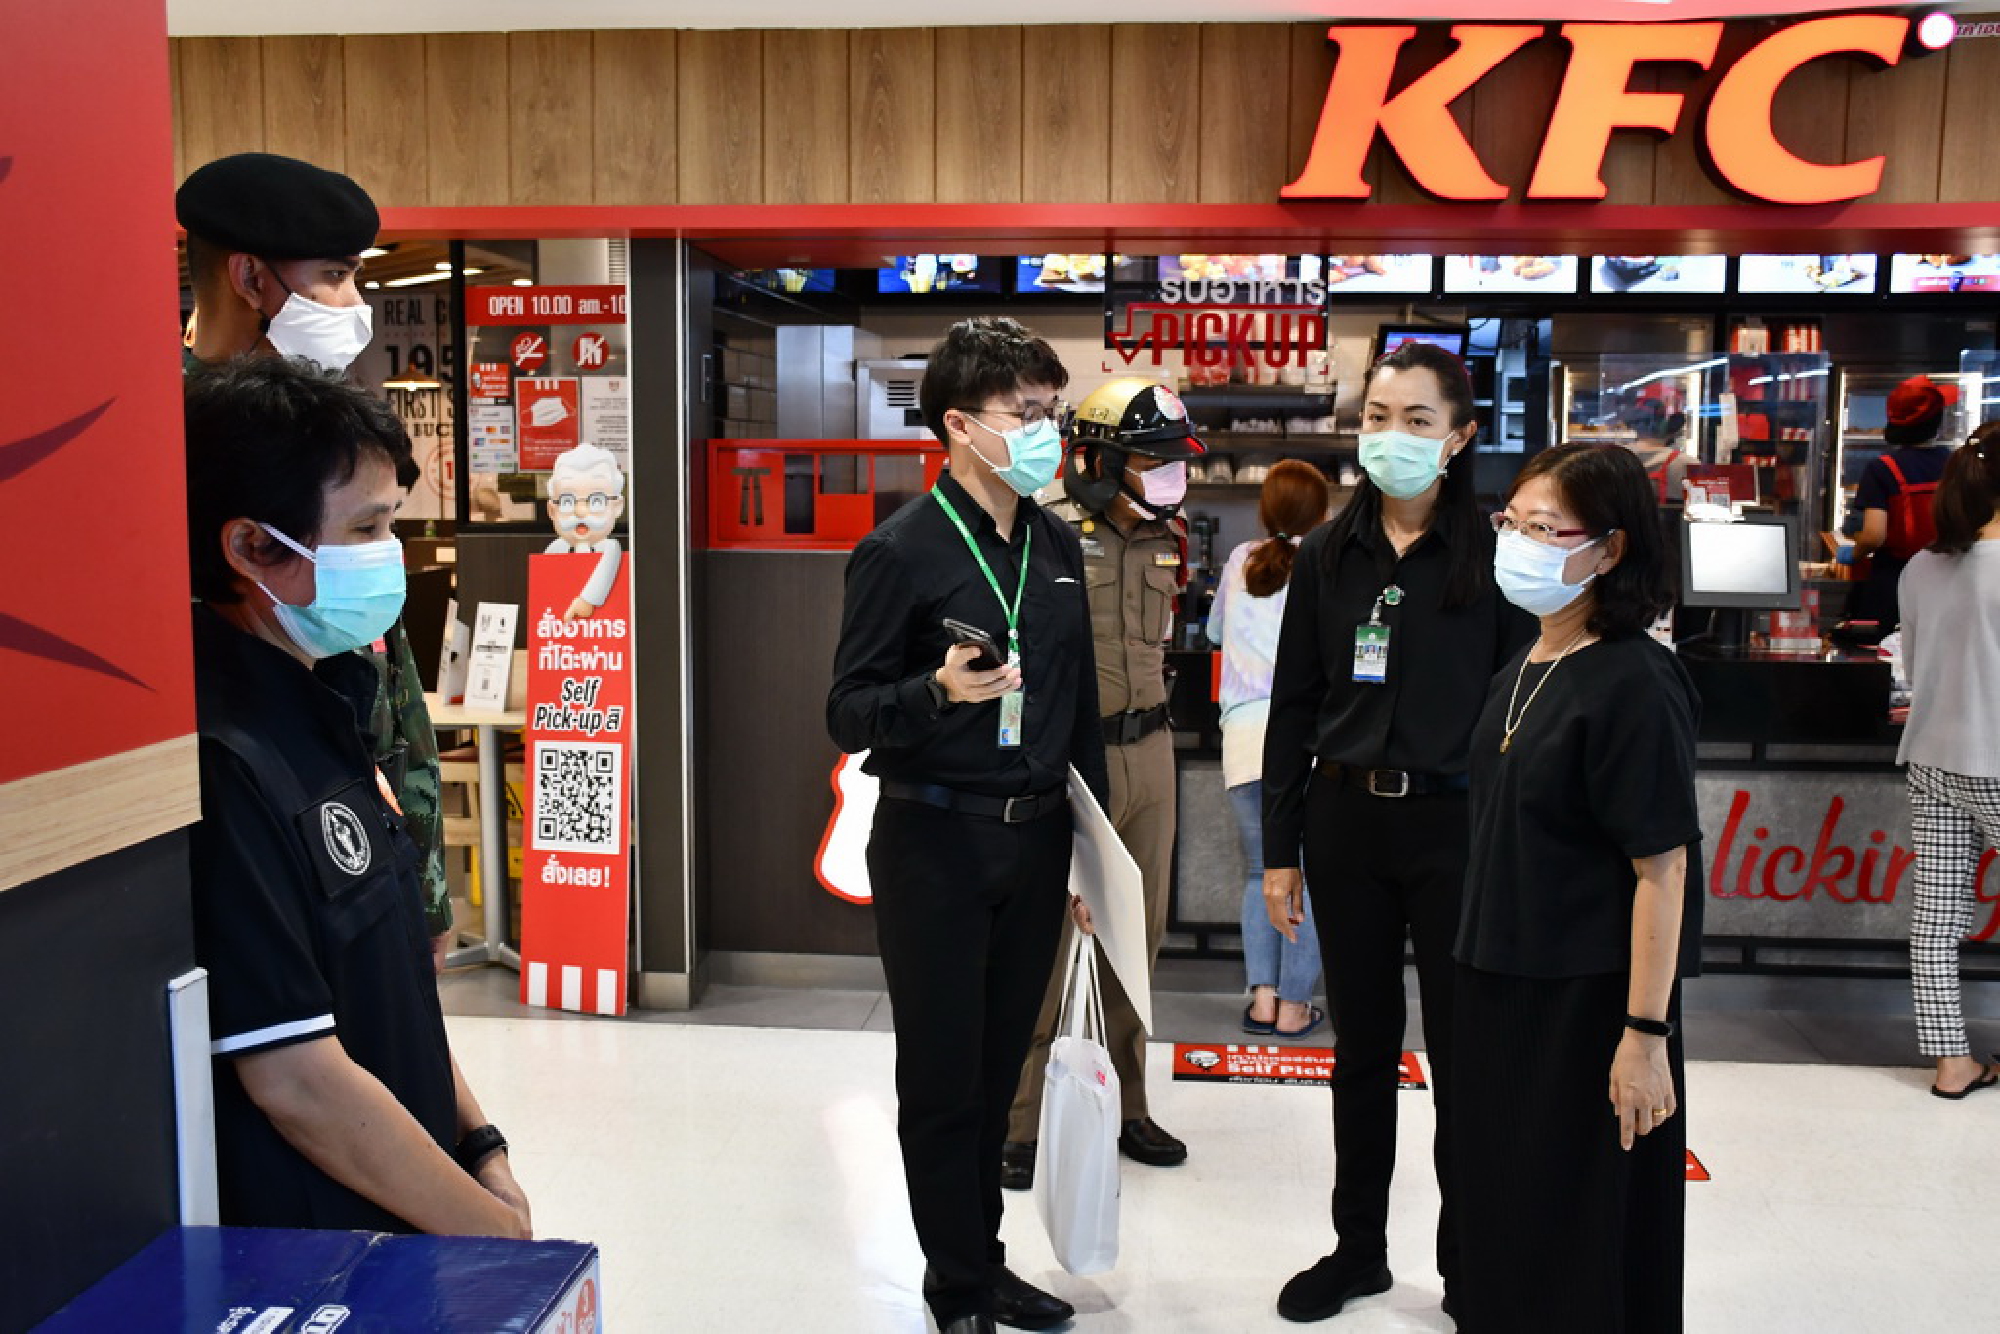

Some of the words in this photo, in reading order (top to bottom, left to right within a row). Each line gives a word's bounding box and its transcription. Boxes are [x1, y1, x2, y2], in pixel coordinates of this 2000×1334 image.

[1279, 15, 1909, 204] KFC
[384, 299, 426, 325] REAL
[488, 294, 525, 316] OPEN
[531, 294, 573, 316] 10.00
[536, 607, 627, 638] สั่งอาหาร
[538, 641, 623, 671] ที่โต๊ะผ่าน
[561, 677, 602, 708] Self
[533, 703, 603, 734] Pick-up
